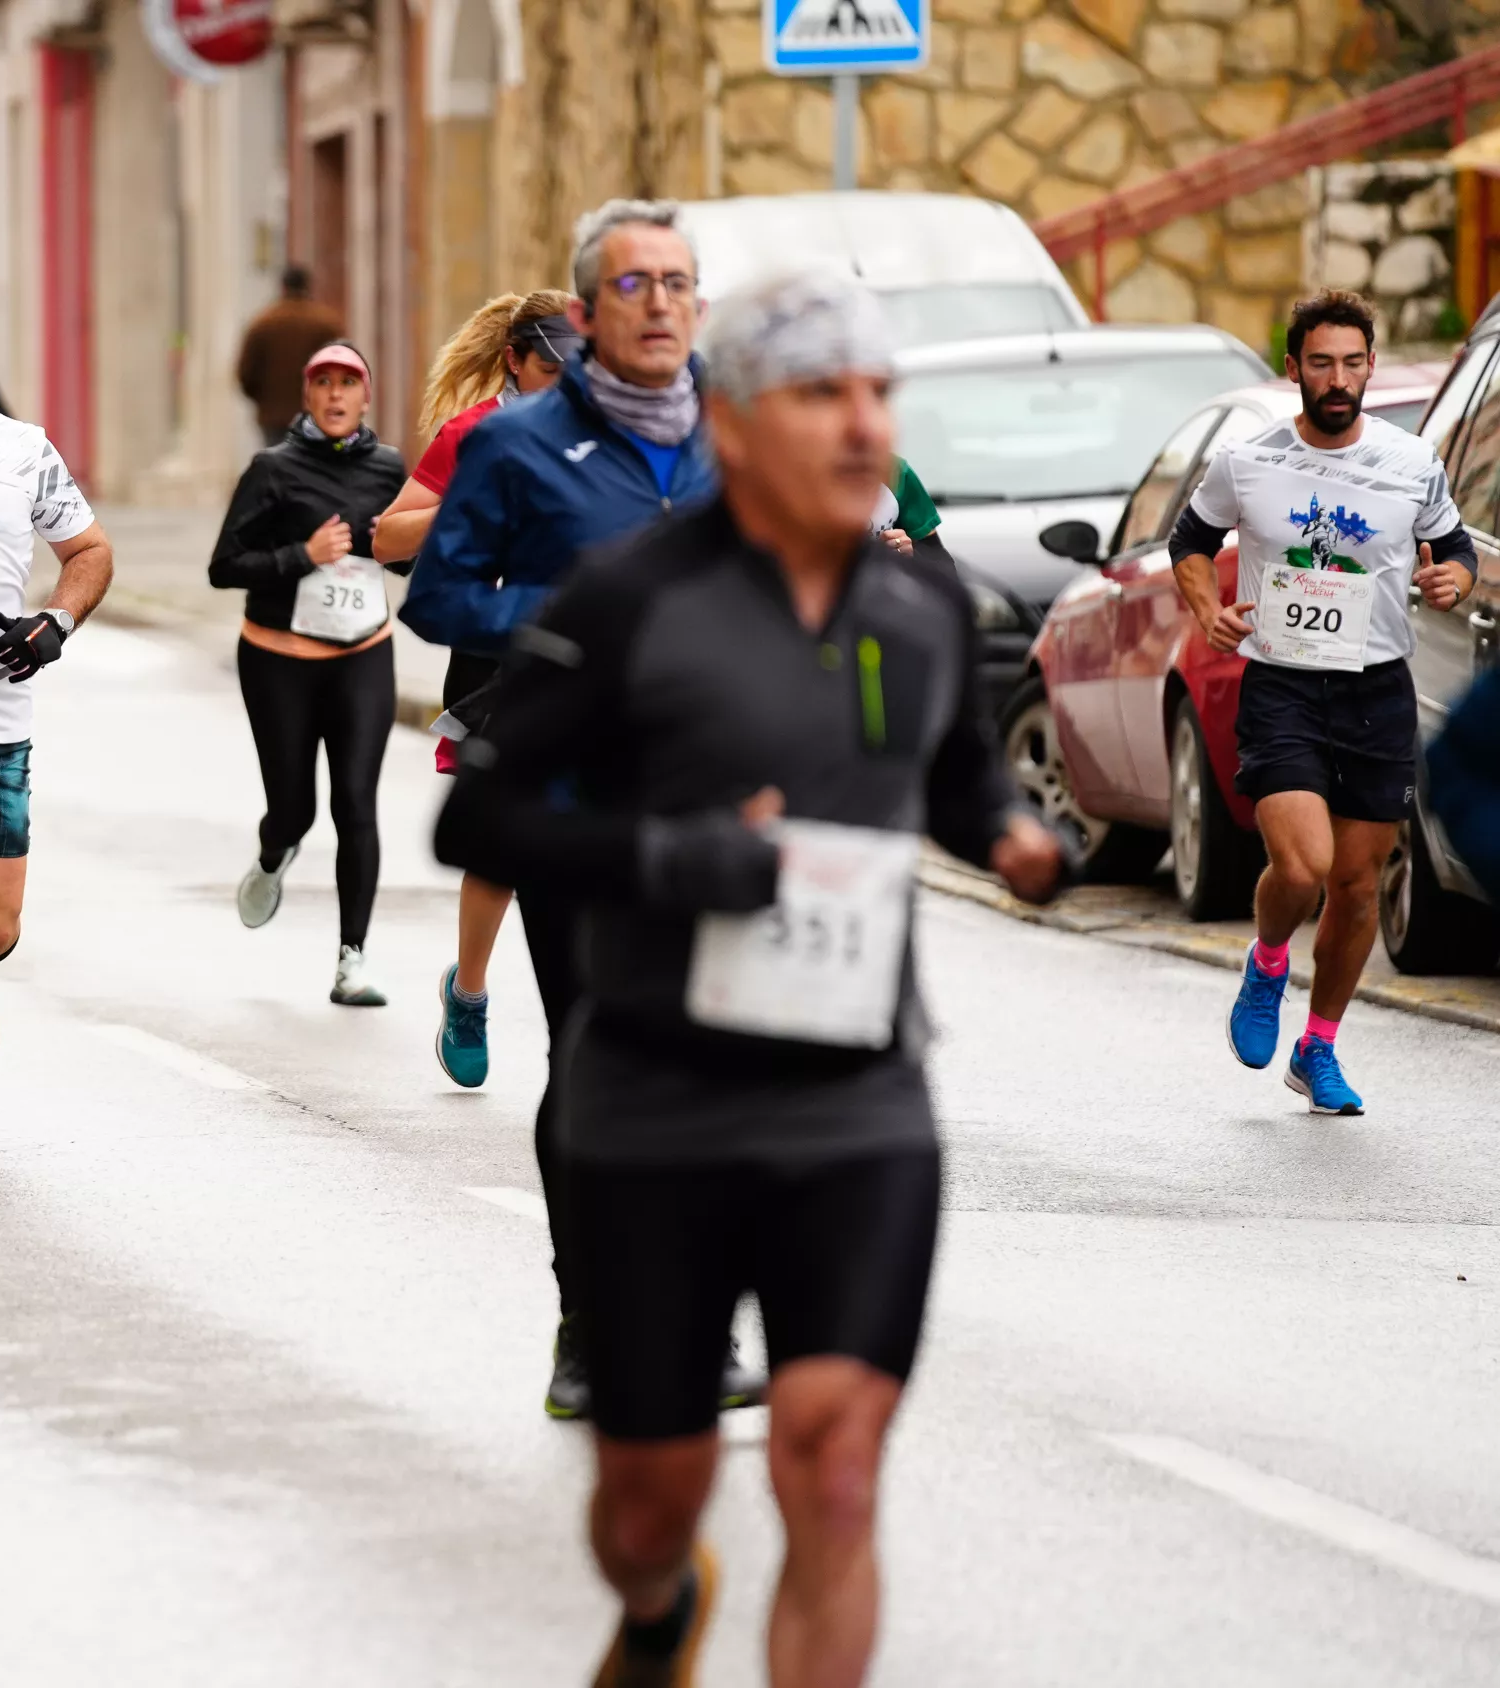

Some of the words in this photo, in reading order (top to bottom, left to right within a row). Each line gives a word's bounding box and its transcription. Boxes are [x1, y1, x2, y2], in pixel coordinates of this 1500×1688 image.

[322, 585, 365, 609] 378
[1303, 586, 1338, 599] LUCENA
[1285, 603, 1342, 633] 920
